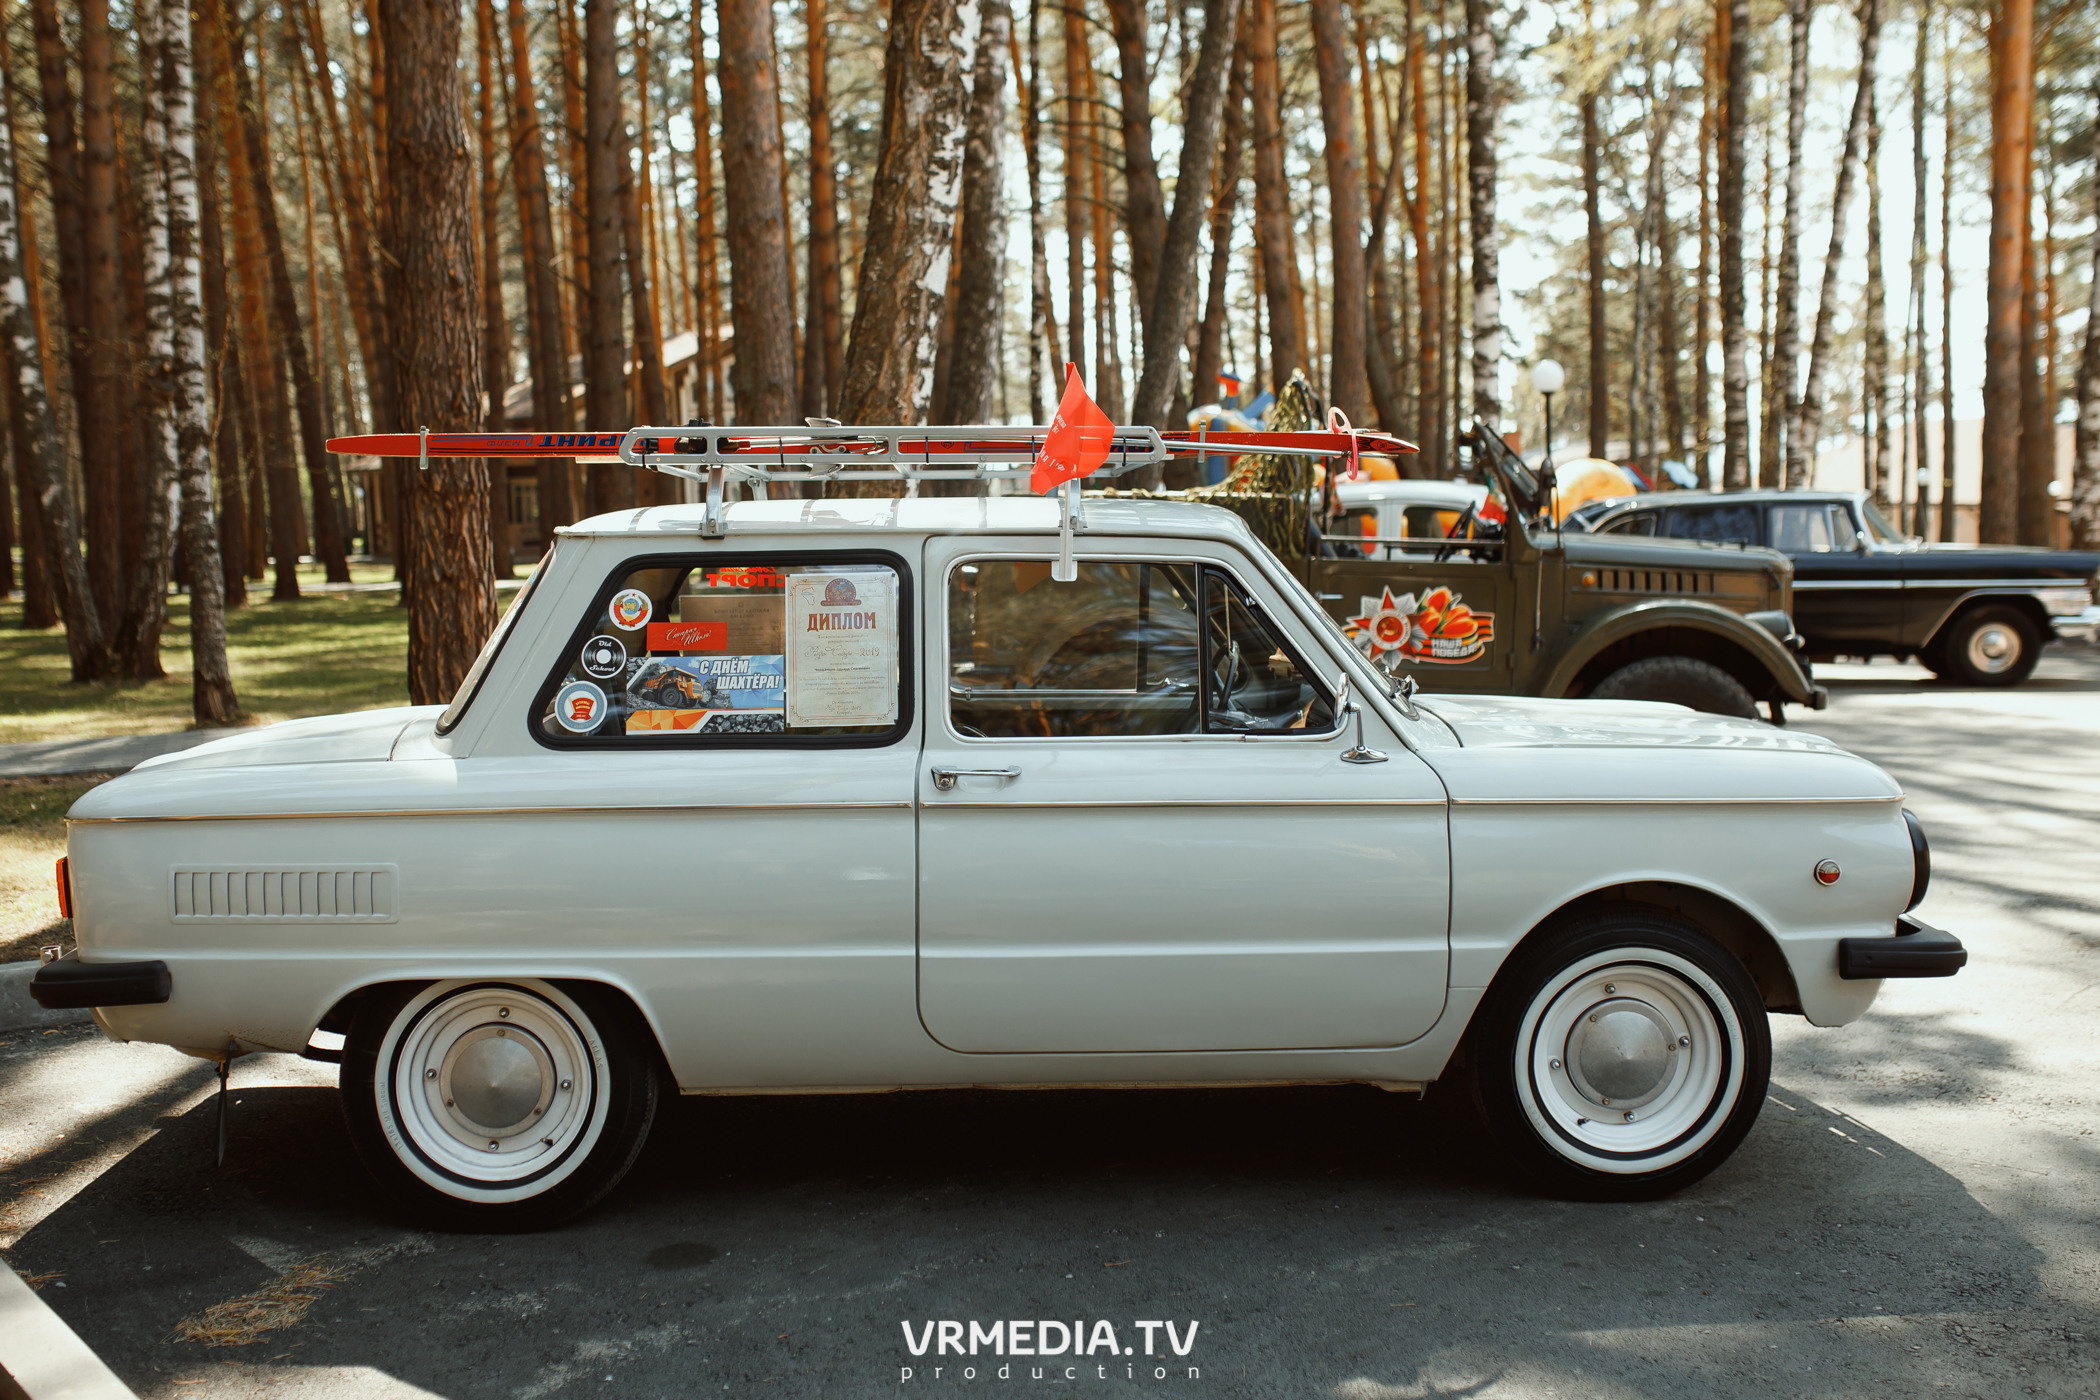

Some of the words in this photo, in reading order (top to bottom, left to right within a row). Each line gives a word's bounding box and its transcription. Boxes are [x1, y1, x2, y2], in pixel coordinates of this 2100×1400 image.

[807, 612, 877, 632] ДИПЛОМ
[665, 627, 697, 641] Старая
[1431, 637, 1462, 648] НАША
[589, 664, 616, 672] School
[699, 660, 710, 675] С
[709, 657, 750, 676] ДНЁМ
[716, 673, 780, 690] ШАХТЁРА!
